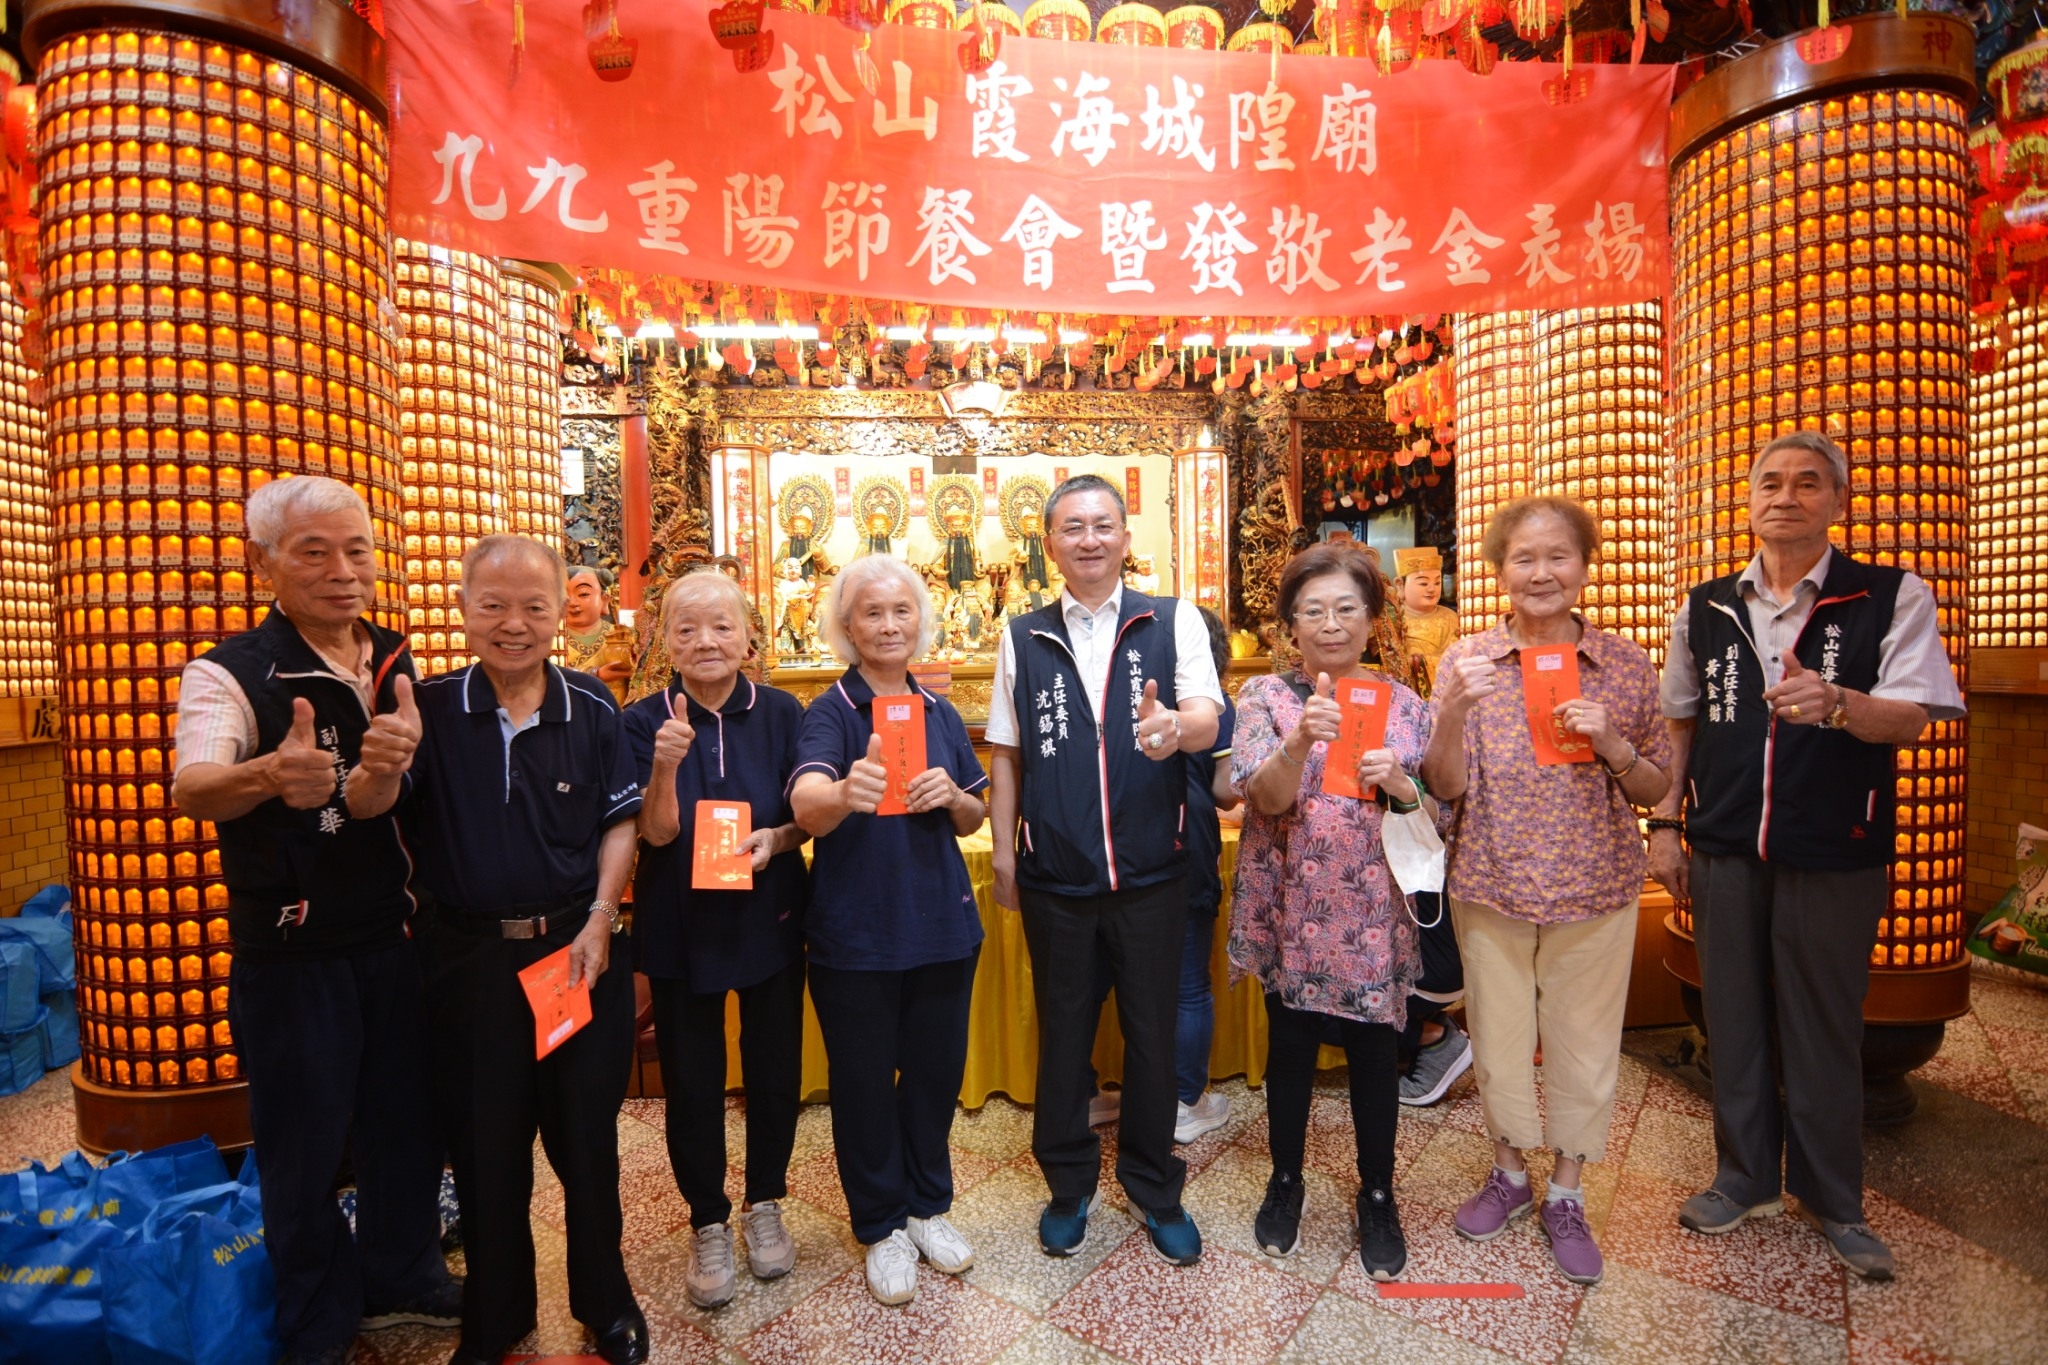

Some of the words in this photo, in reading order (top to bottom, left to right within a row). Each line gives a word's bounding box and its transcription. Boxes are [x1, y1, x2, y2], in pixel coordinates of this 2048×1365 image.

[1922, 21, 1953, 65] 神
[767, 43, 1378, 176] 松山霞海城隍廟
[432, 131, 1647, 298] 九九重陽節餐會暨發敬老金表揚
[1053, 673, 1069, 740] 主任委員
[1723, 643, 1739, 723] 副主任委員
